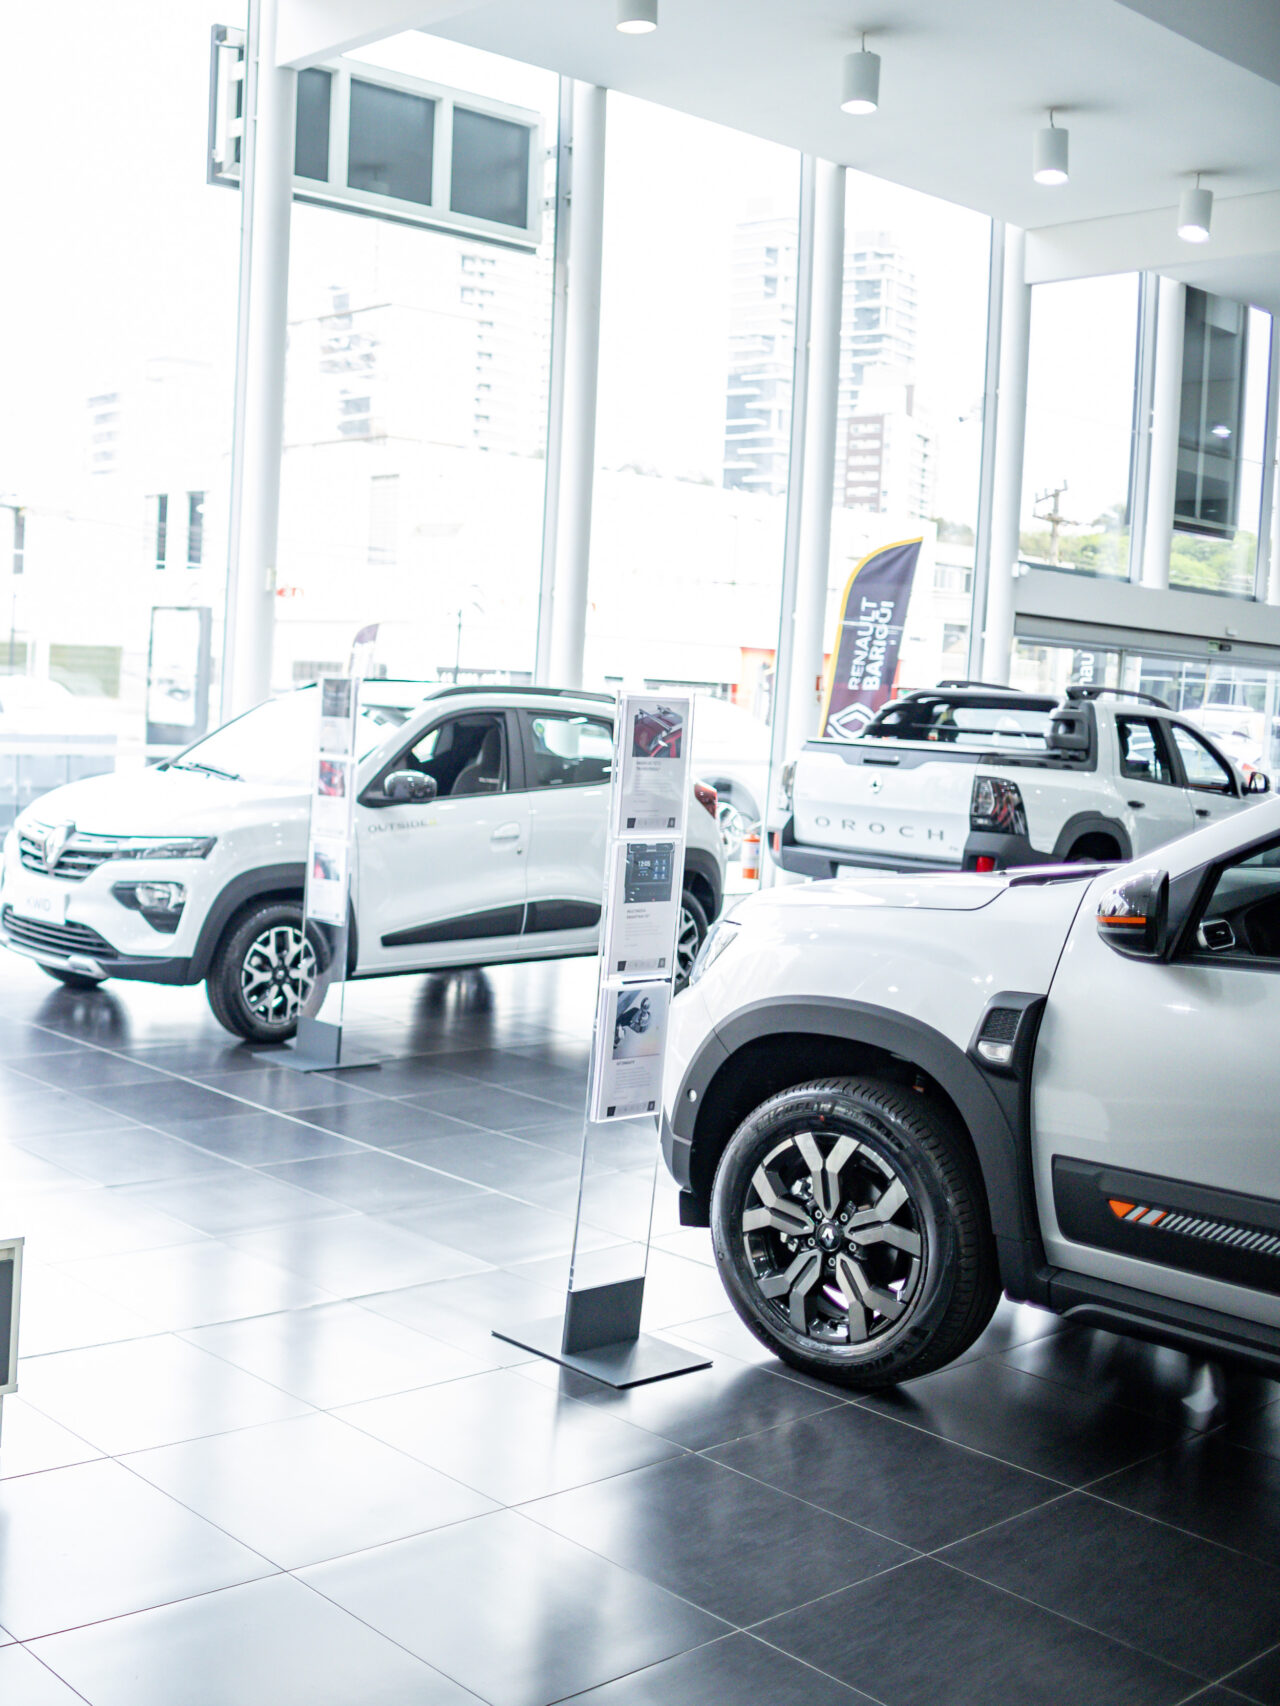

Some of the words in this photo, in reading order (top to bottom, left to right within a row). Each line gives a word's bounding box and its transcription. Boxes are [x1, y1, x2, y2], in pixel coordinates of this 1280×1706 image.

[847, 596, 877, 690] RENAULT
[862, 601, 895, 691] BARIGUI
[815, 816, 944, 841] OROCH
